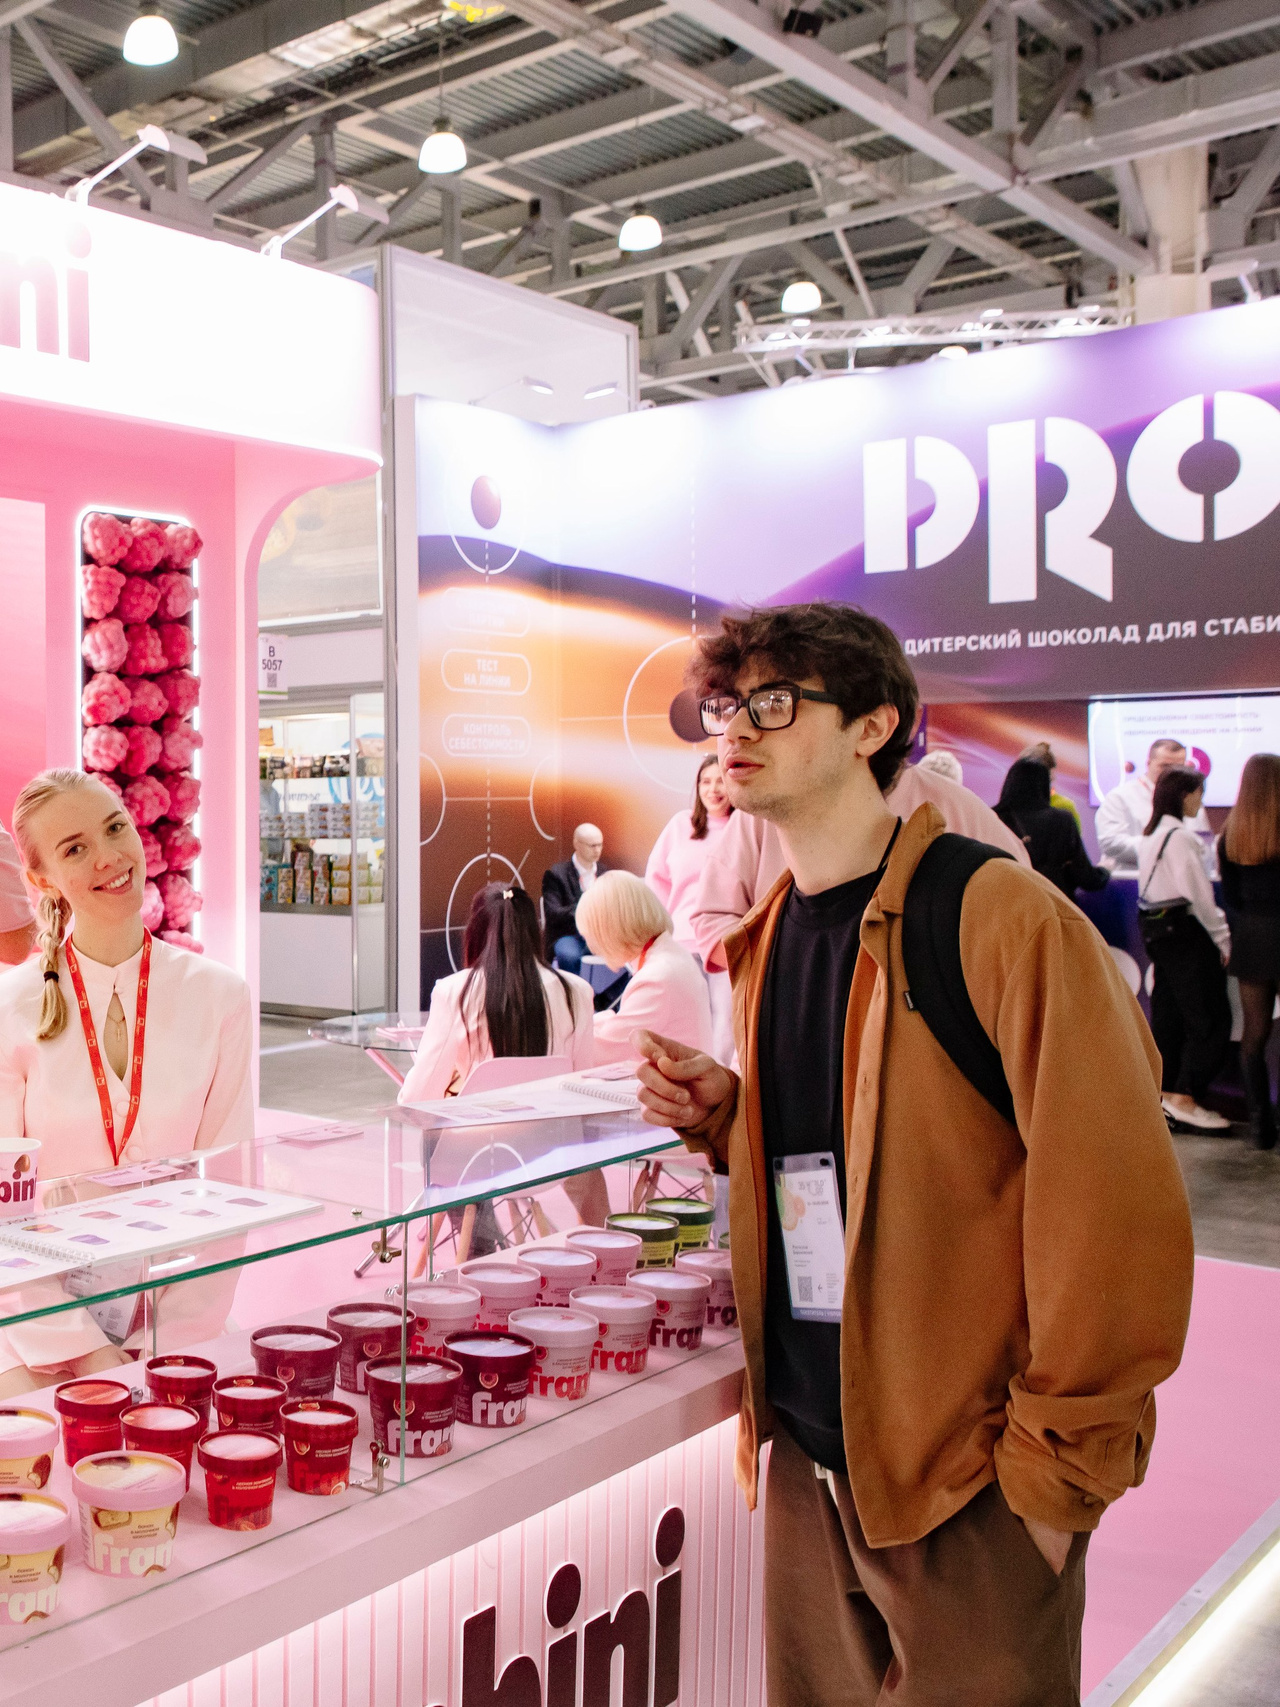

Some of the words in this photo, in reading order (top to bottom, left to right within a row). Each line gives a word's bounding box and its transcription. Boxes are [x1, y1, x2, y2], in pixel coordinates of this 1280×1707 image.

[863, 390, 1280, 604] PRO
[1028, 624, 1141, 648] ШОКОЛАД
[1146, 620, 1196, 643] ДЛЯ
[262, 659, 282, 671] 5057
[476, 658, 499, 672] ТЕСТ
